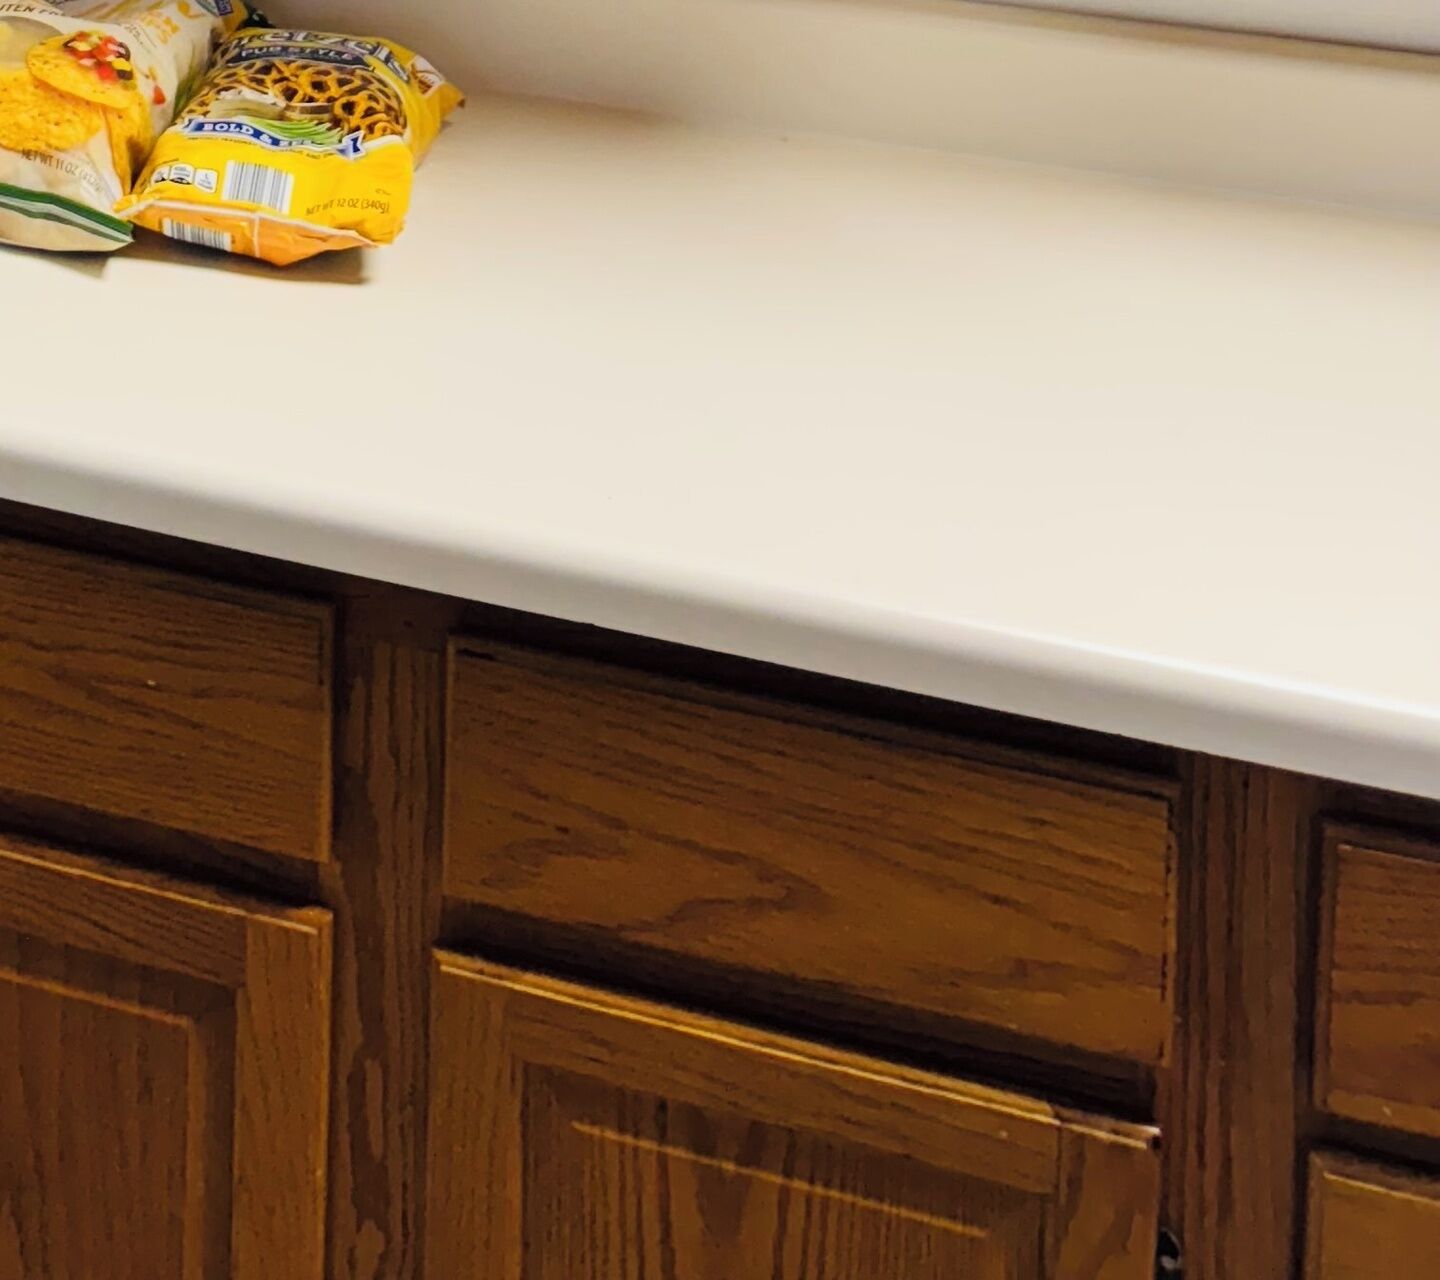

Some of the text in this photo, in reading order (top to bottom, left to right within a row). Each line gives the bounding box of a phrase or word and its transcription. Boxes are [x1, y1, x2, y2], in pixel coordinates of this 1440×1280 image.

[241, 45, 353, 61] PUB STYLE
[203, 122, 254, 136] BOLD
[259, 135, 273, 146] &
[22, 148, 38, 161] NET
[40, 151, 53, 167] WT
[64, 162, 78, 176] OZ
[305, 204, 321, 216] NET
[337, 198, 346, 208] 12
[347, 198, 359, 208] OZ
[360, 198, 389, 214] (340g)
